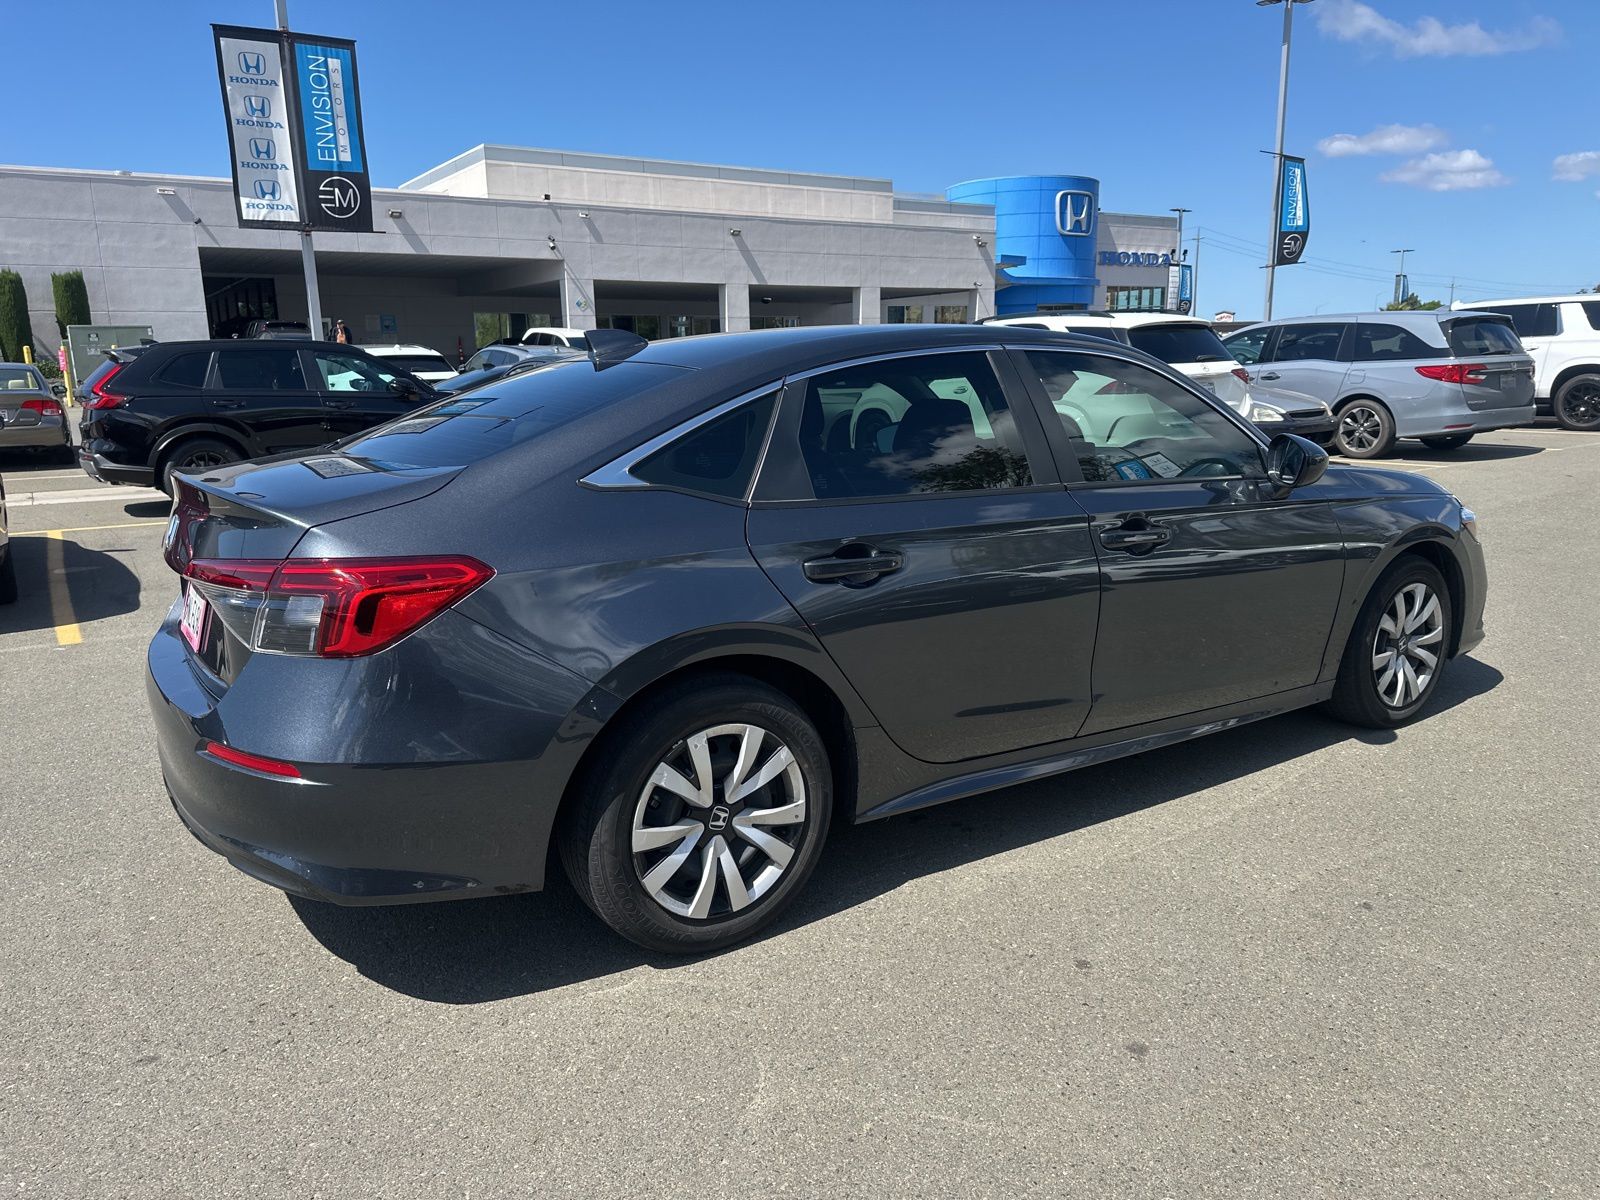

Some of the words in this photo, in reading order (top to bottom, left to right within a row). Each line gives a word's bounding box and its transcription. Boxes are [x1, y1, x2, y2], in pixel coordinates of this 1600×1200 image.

[229, 76, 279, 87] HONDA
[307, 54, 336, 161] ENVISION
[332, 67, 348, 153] MOTORS
[235, 118, 284, 129] HONDA
[241, 161, 289, 171] HONDA
[1286, 166, 1297, 226] ENVISION
[245, 202, 295, 211] HONDA
[1099, 250, 1172, 268] HONDA
